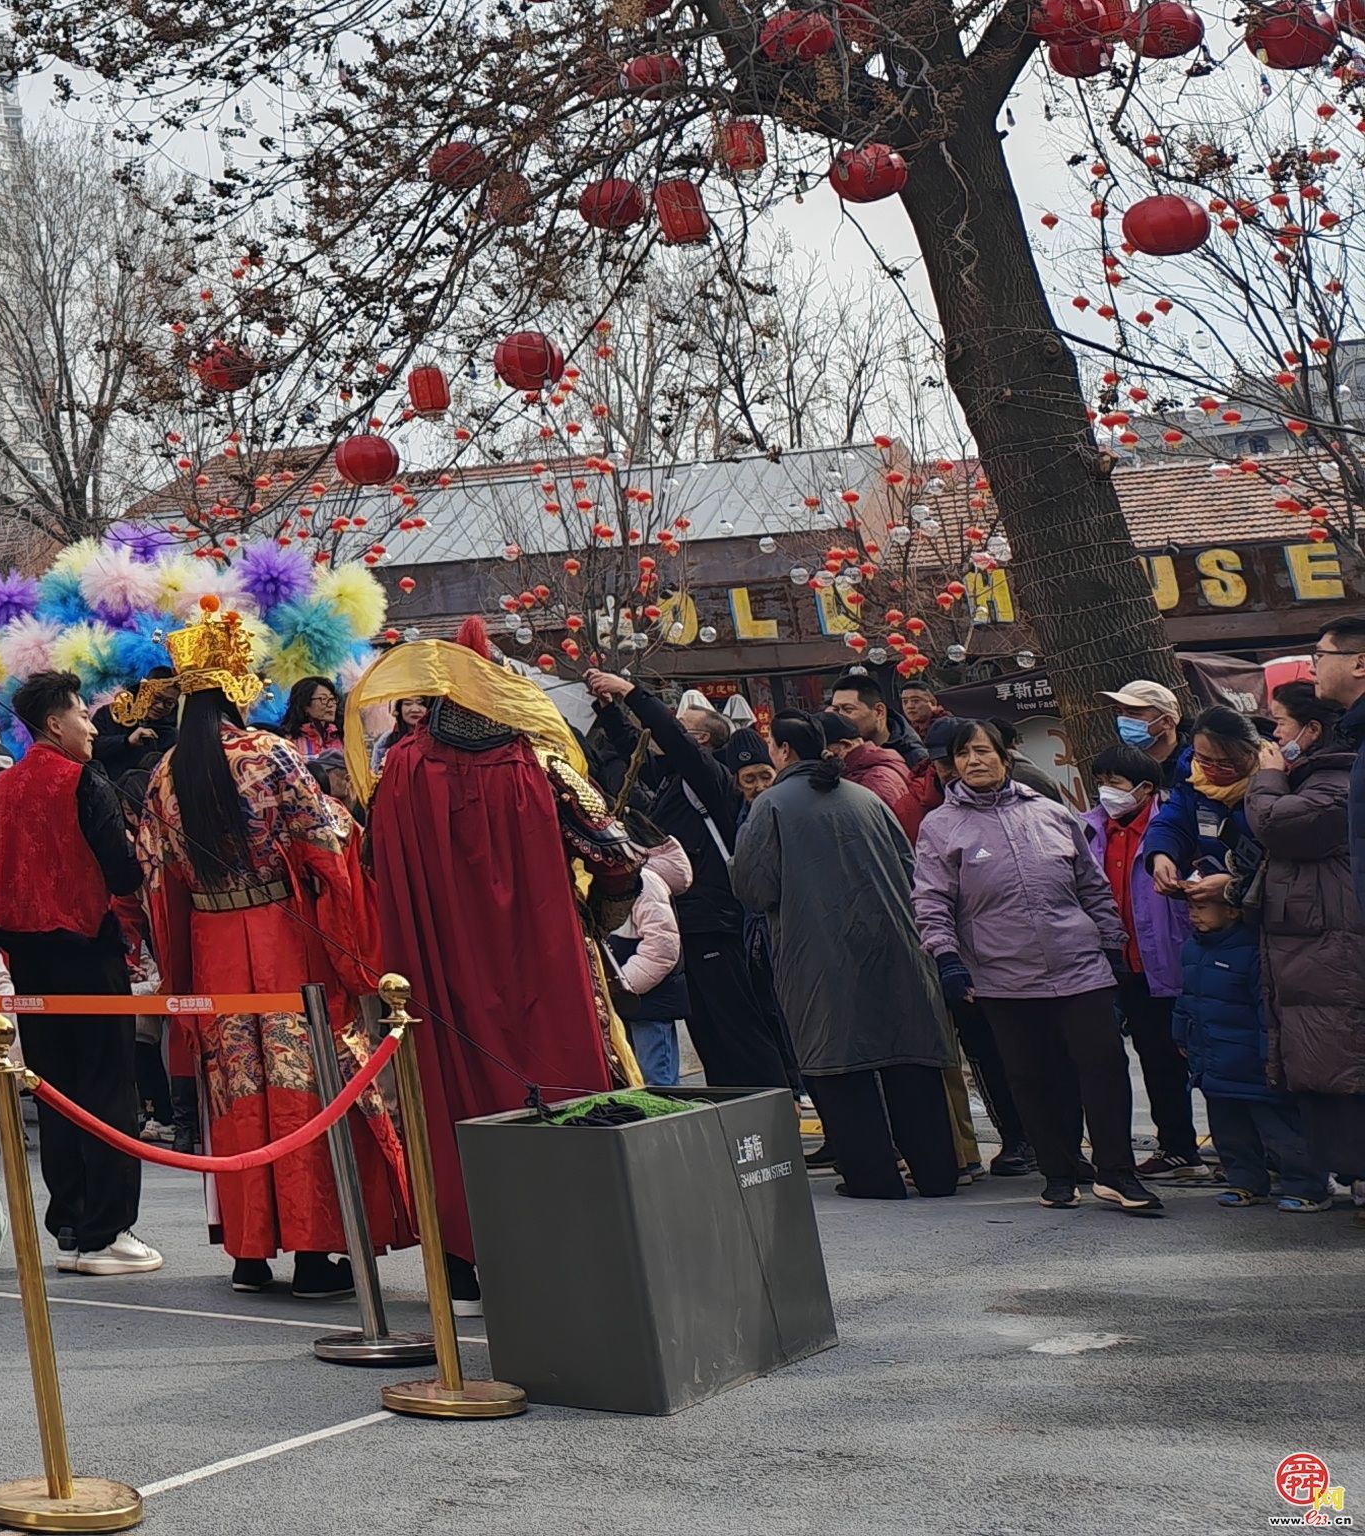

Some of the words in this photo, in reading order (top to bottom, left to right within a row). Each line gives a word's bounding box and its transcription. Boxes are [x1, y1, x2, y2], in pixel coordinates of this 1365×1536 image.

[965, 543, 1346, 625] HUSE
[1017, 701, 1036, 711] New
[736, 1134, 764, 1164] 上新街
[740, 1169, 762, 1188] SHANG
[771, 1161, 792, 1179] STREET
